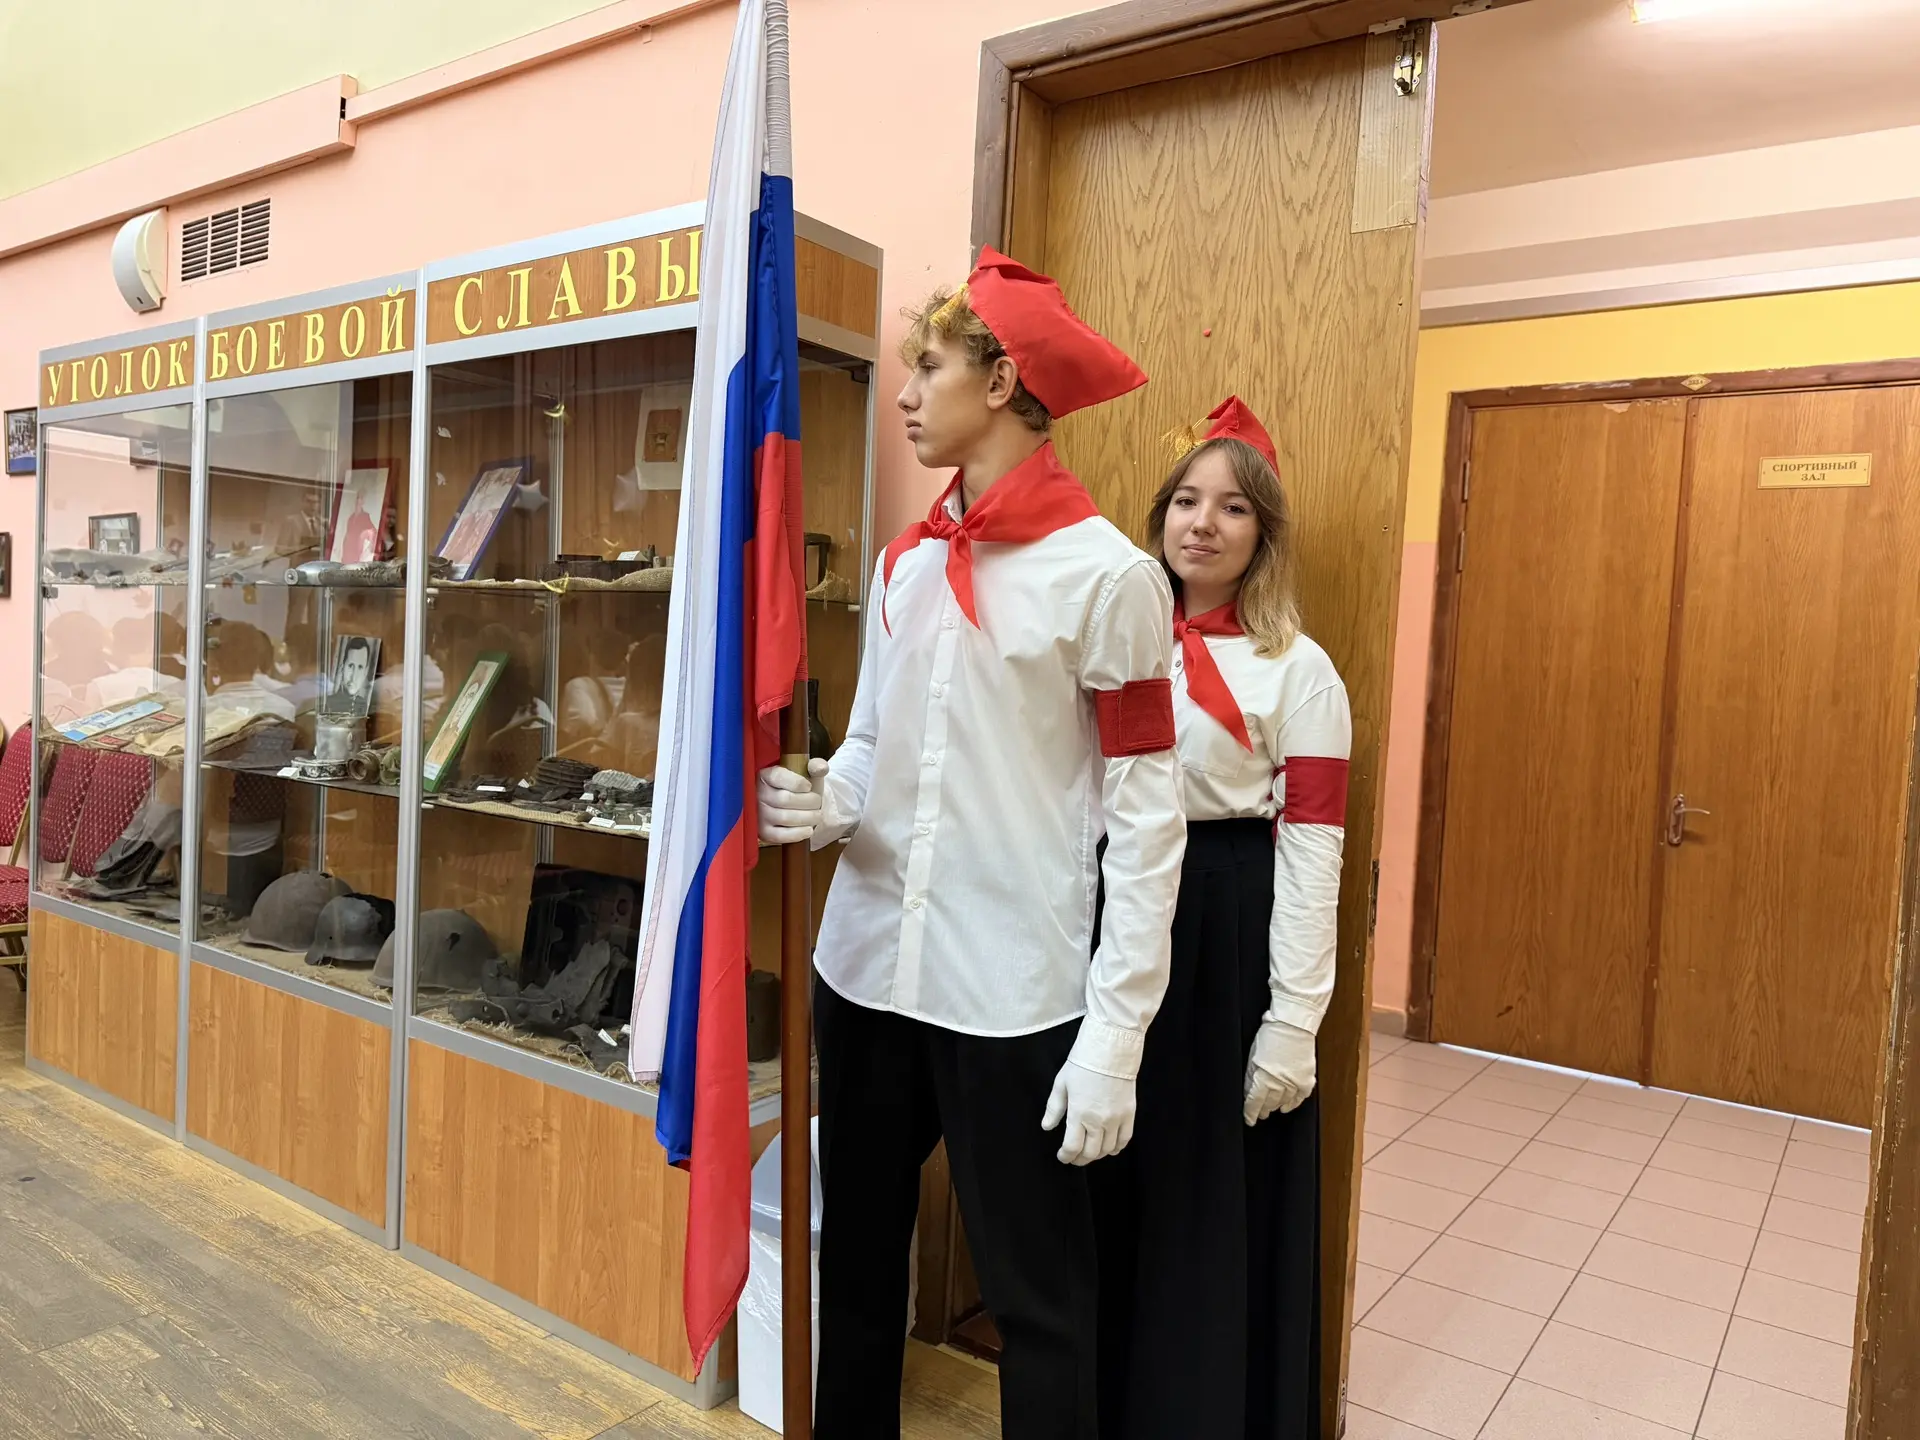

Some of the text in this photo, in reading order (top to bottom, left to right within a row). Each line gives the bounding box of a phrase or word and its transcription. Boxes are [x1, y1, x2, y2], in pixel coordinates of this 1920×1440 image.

[47, 230, 702, 407] УГОЛОК БОЕВОЙ СЛАВЫ
[1772, 460, 1857, 472] СПОРТИВНЫЙ
[1801, 473, 1826, 481] ЗАЛ
